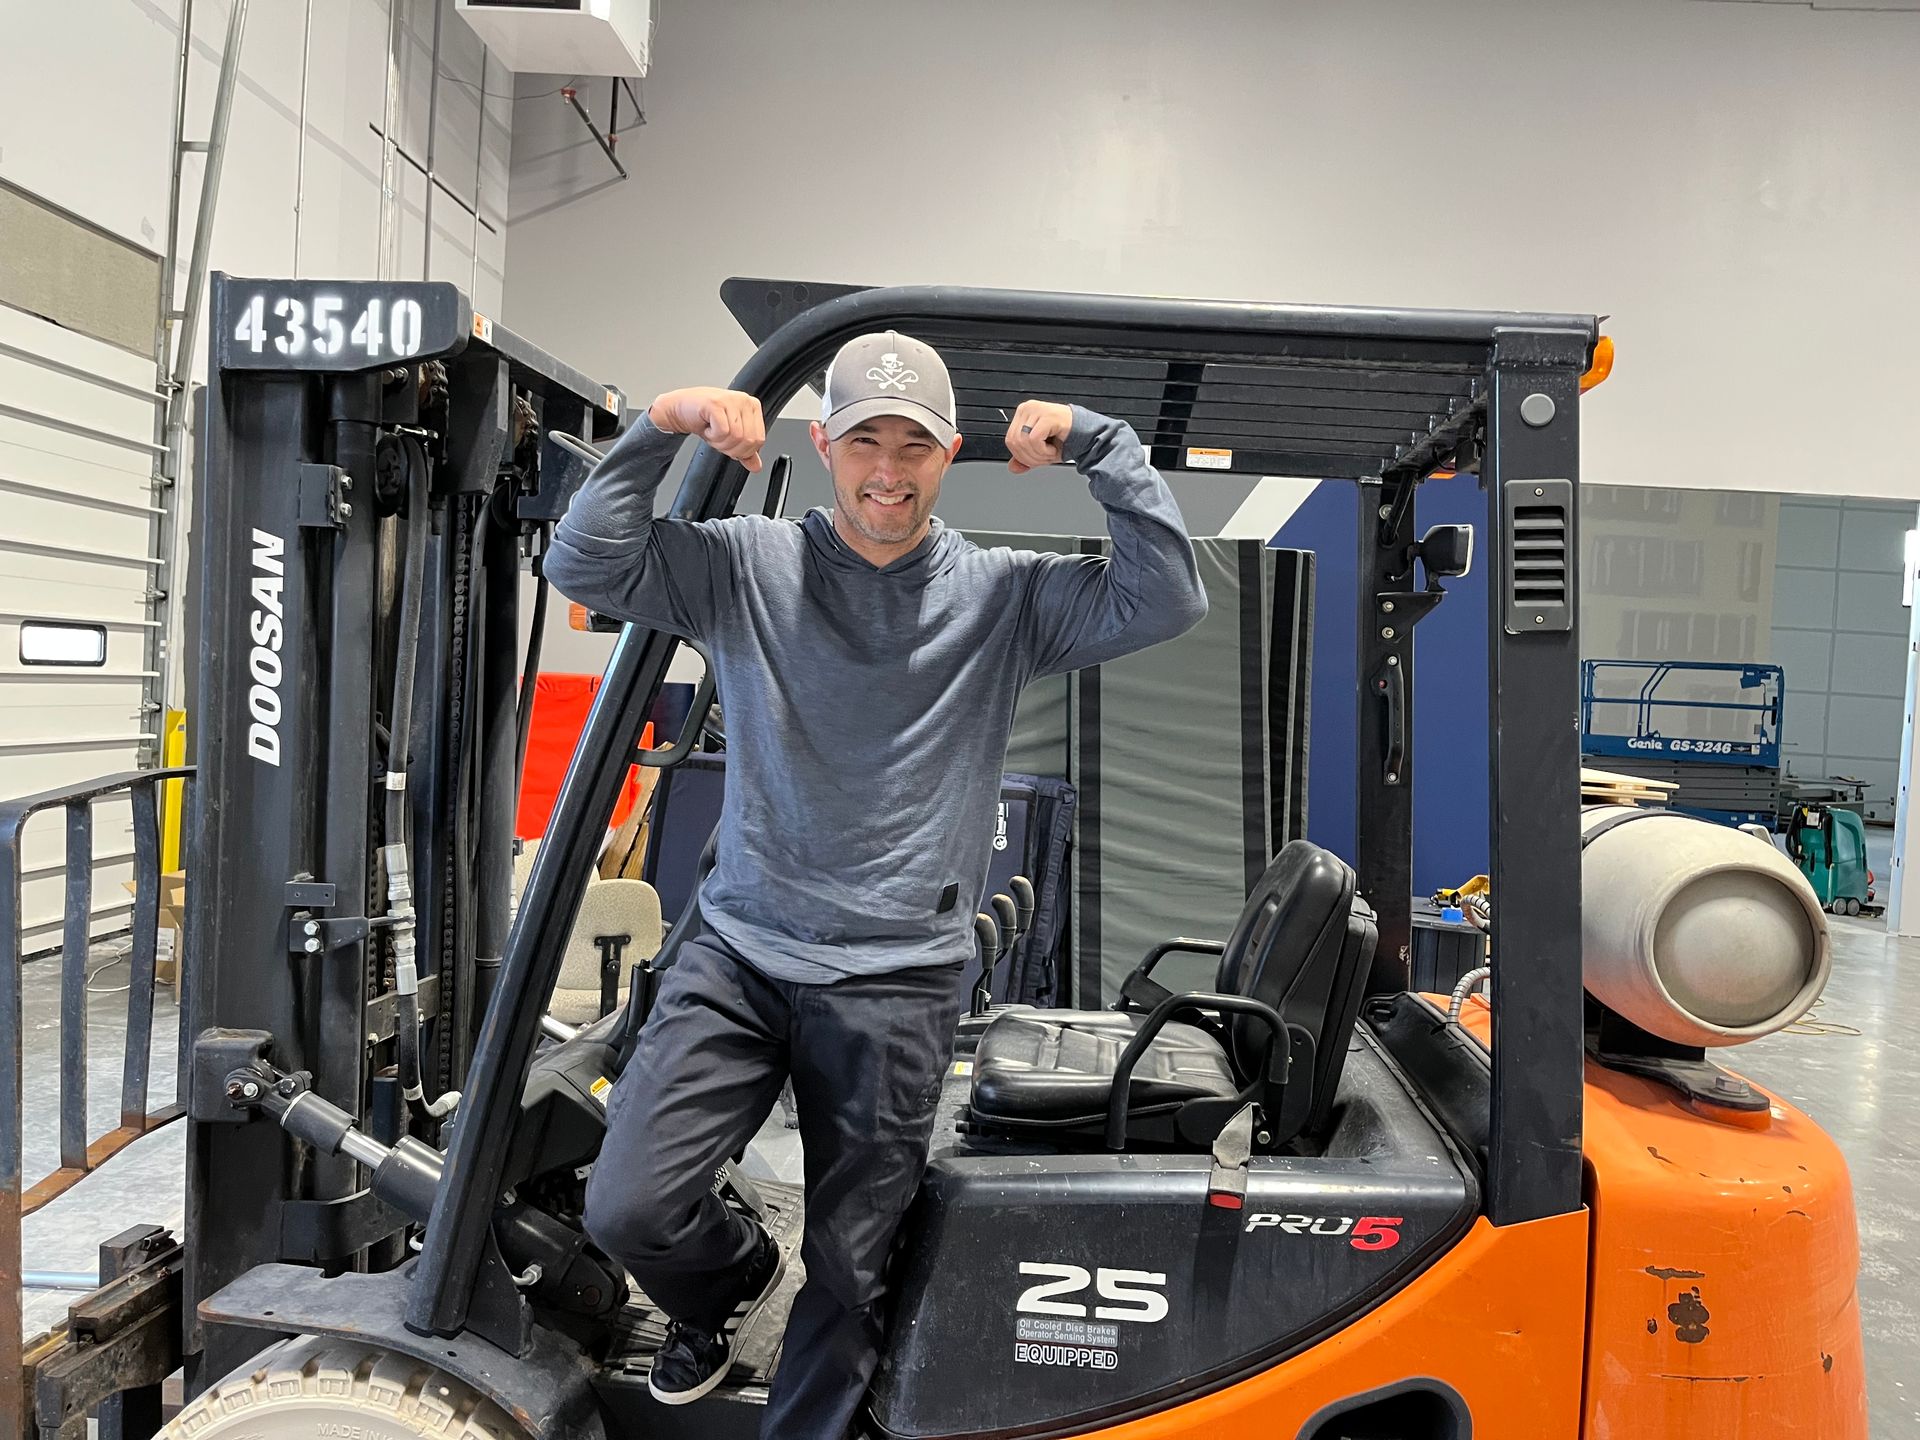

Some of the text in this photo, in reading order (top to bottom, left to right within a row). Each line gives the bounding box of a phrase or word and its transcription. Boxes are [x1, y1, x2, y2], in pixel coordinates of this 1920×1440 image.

[235, 296, 422, 357] 43540
[248, 527, 284, 767] DOOSAN
[1627, 738, 1663, 750] Genie
[1670, 740, 1732, 754] GS-3246
[1016, 1262, 1169, 1323] 25
[1019, 1319, 1116, 1336] Oil Cooled Disc Brakes
[1019, 1328, 1116, 1345] Operator Sensing System
[1015, 1342, 1118, 1370] EQUIPPED
[317, 1423, 361, 1440] MADE
